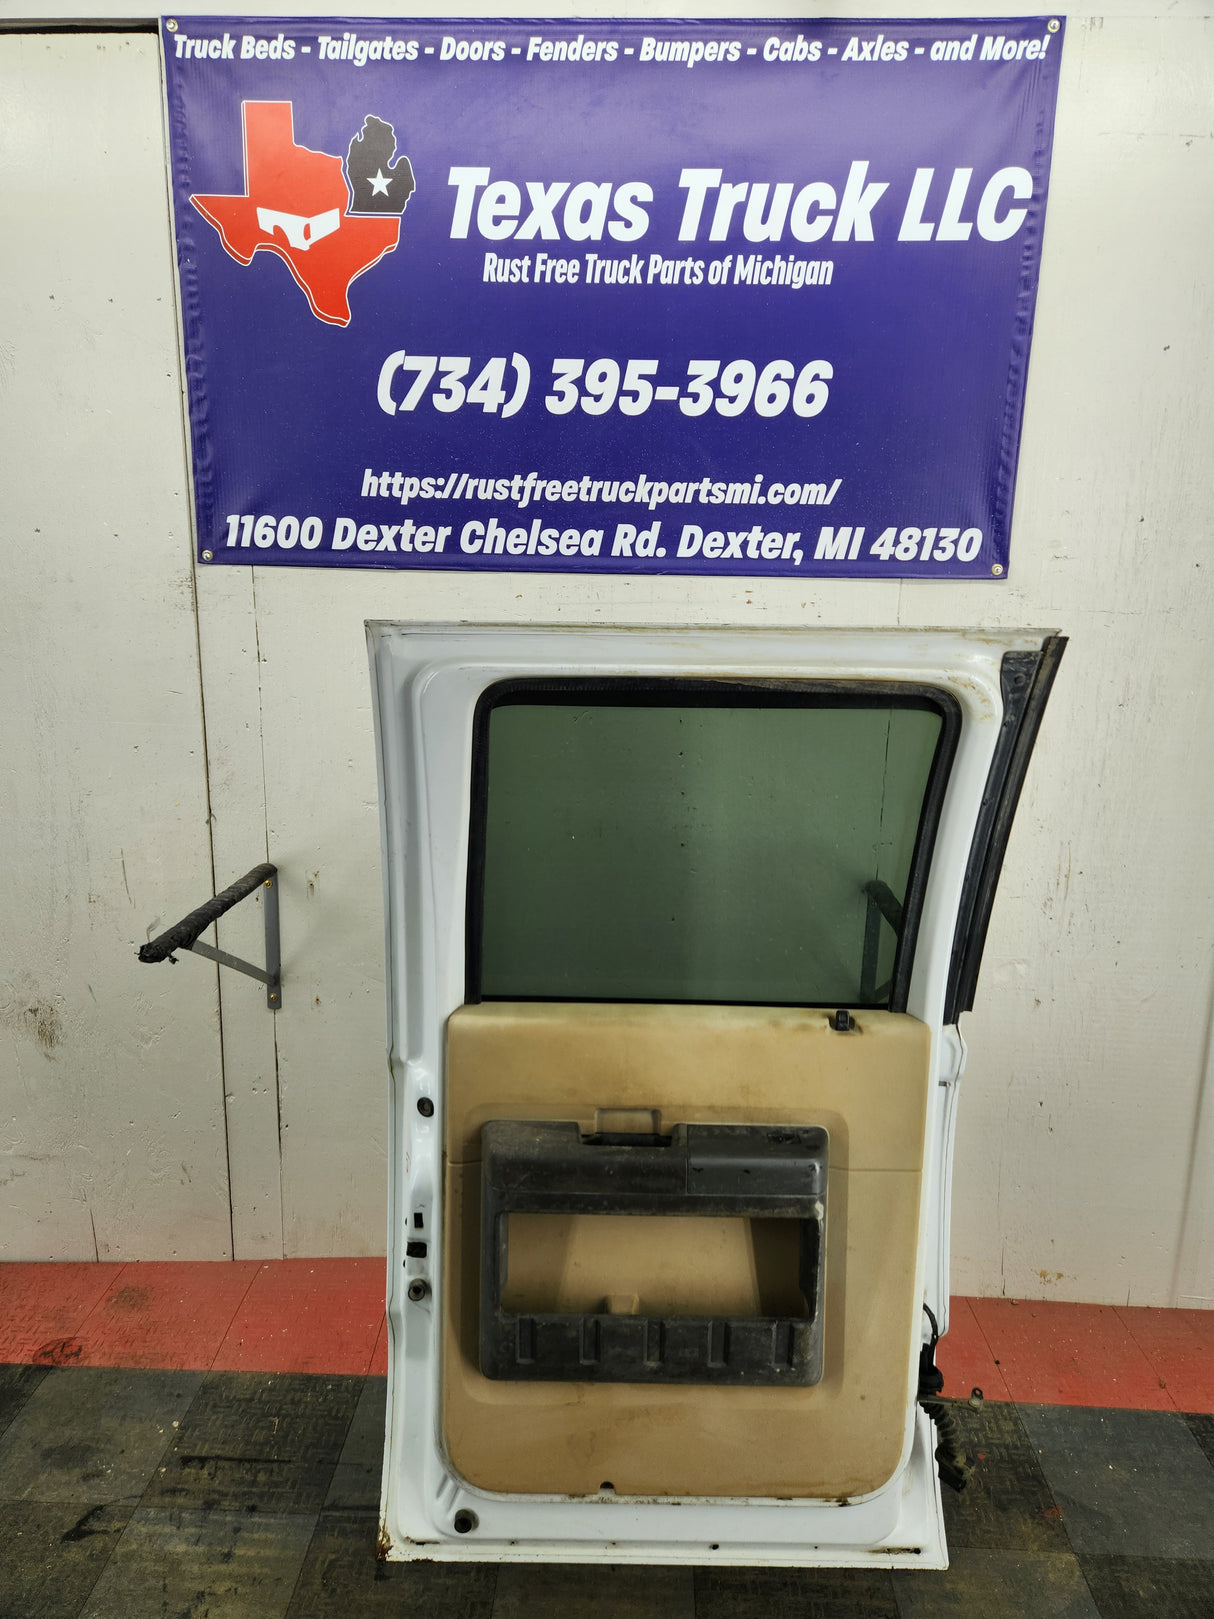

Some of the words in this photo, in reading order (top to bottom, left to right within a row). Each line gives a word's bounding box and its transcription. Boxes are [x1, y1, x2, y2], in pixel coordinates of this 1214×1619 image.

[174, 33, 237, 60] Truck
[240, 33, 296, 60] Beds
[318, 33, 420, 67] Tailgates
[439, 36, 506, 61] Doors
[526, 34, 619, 62] Fenders
[639, 37, 742, 68] Bumpers
[763, 34, 823, 62] Cabs
[841, 34, 910, 62] Axles
[930, 33, 979, 61] and
[979, 34, 1051, 61] More!
[447, 166, 654, 242] Texas
[677, 160, 890, 243] Truck
[897, 166, 1034, 242] LLC
[483, 252, 531, 284] Rust
[534, 253, 580, 284] Free
[585, 253, 645, 285] Truck
[647, 254, 705, 286] Parts
[708, 254, 735, 286] of
[733, 254, 834, 290] Michigan
[377, 350, 530, 418] (734)
[545, 358, 834, 418] 395-3966
[361, 468, 843, 511] https://rustfreetruckpartsmi.com/
[226, 515, 323, 550] 11600
[332, 518, 453, 553] Dexter
[460, 518, 605, 557] Chelsea
[611, 521, 667, 558] Rd.
[677, 525, 803, 566] Dexter,
[814, 527, 865, 561] MI
[870, 527, 984, 563] 48130
